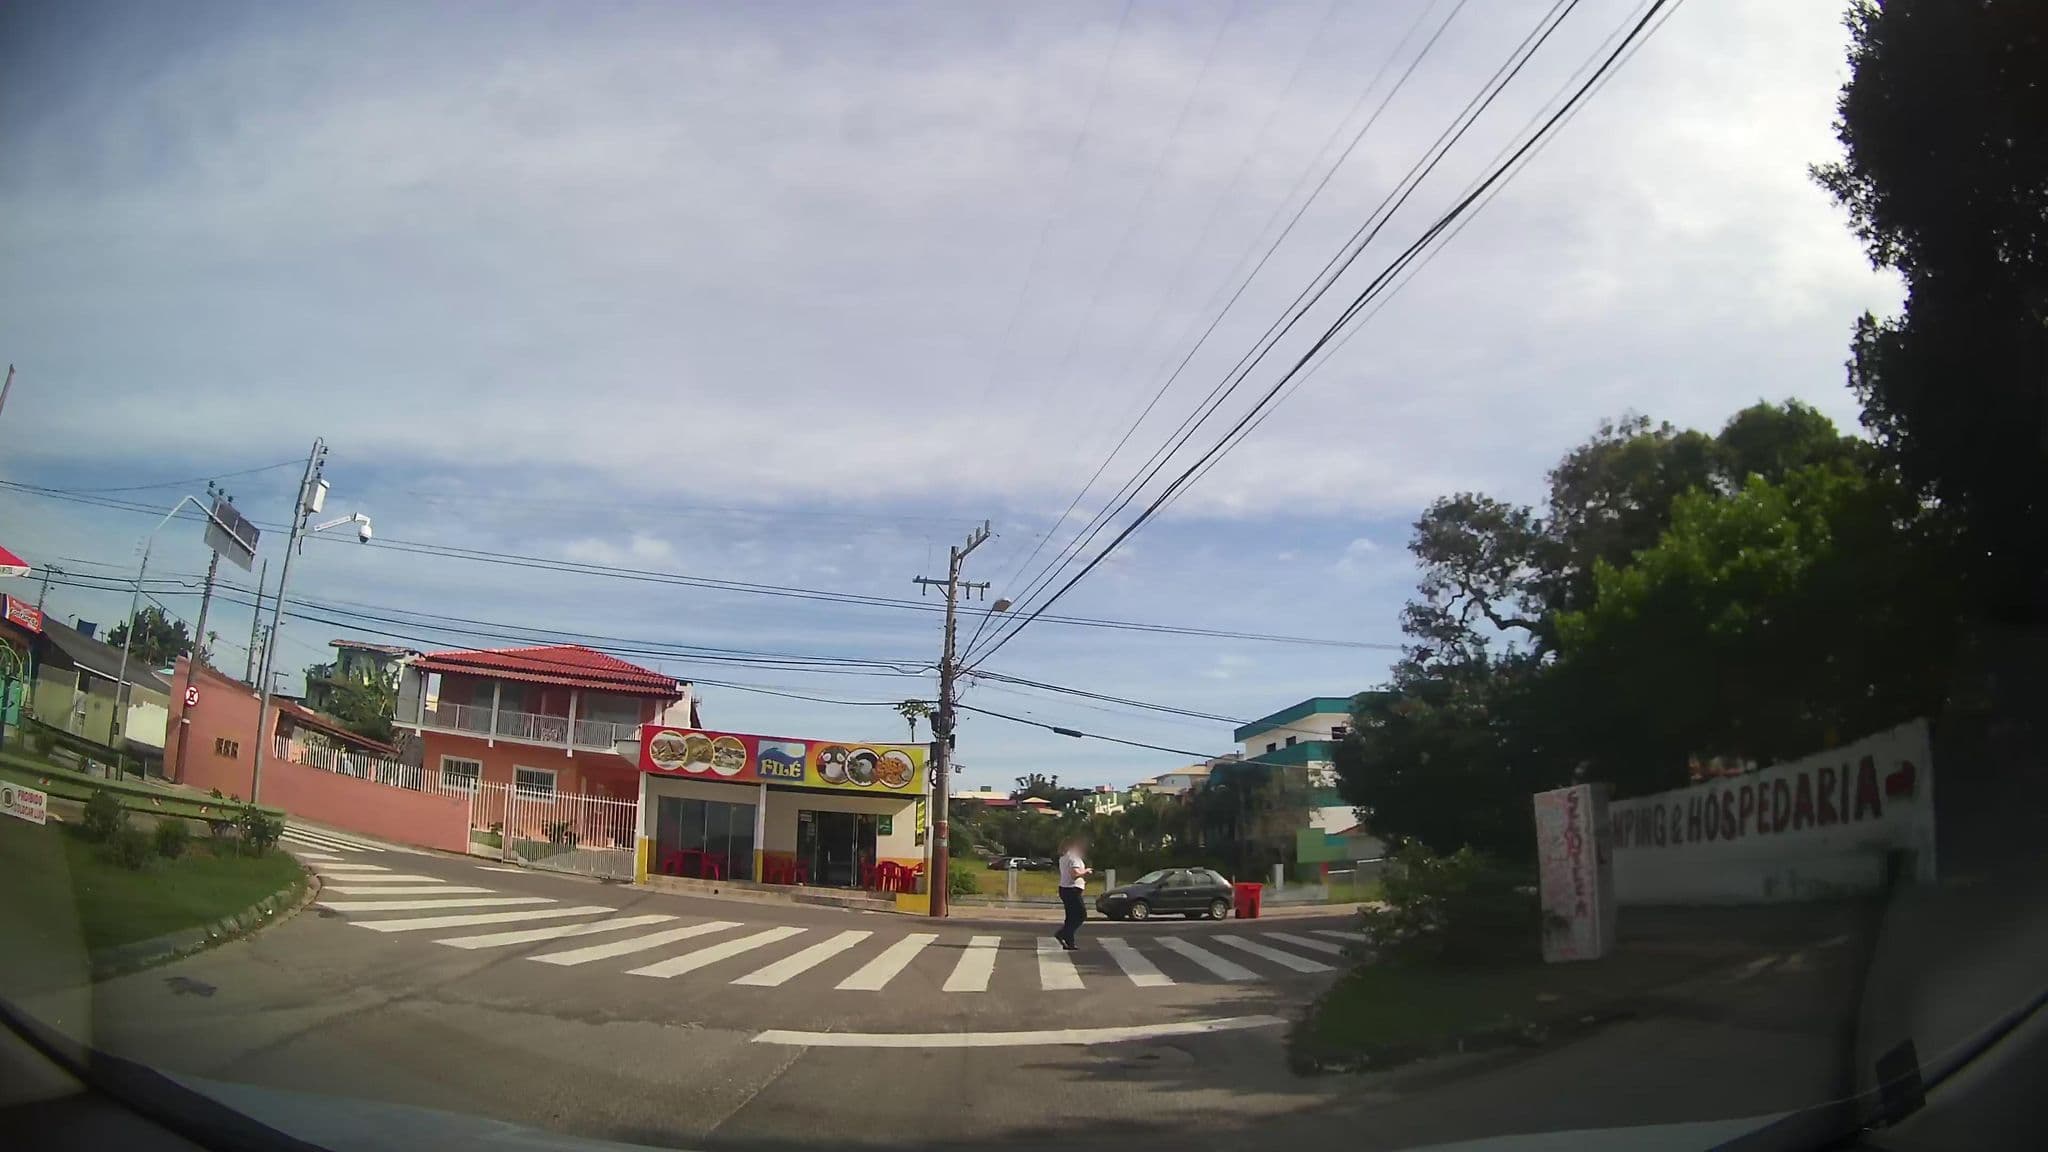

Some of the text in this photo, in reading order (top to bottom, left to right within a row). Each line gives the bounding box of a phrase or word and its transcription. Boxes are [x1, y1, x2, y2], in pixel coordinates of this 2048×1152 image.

[760, 759, 802, 778] FILÉ
[1612, 756, 1882, 849] MPING & HOSPEDARIA
